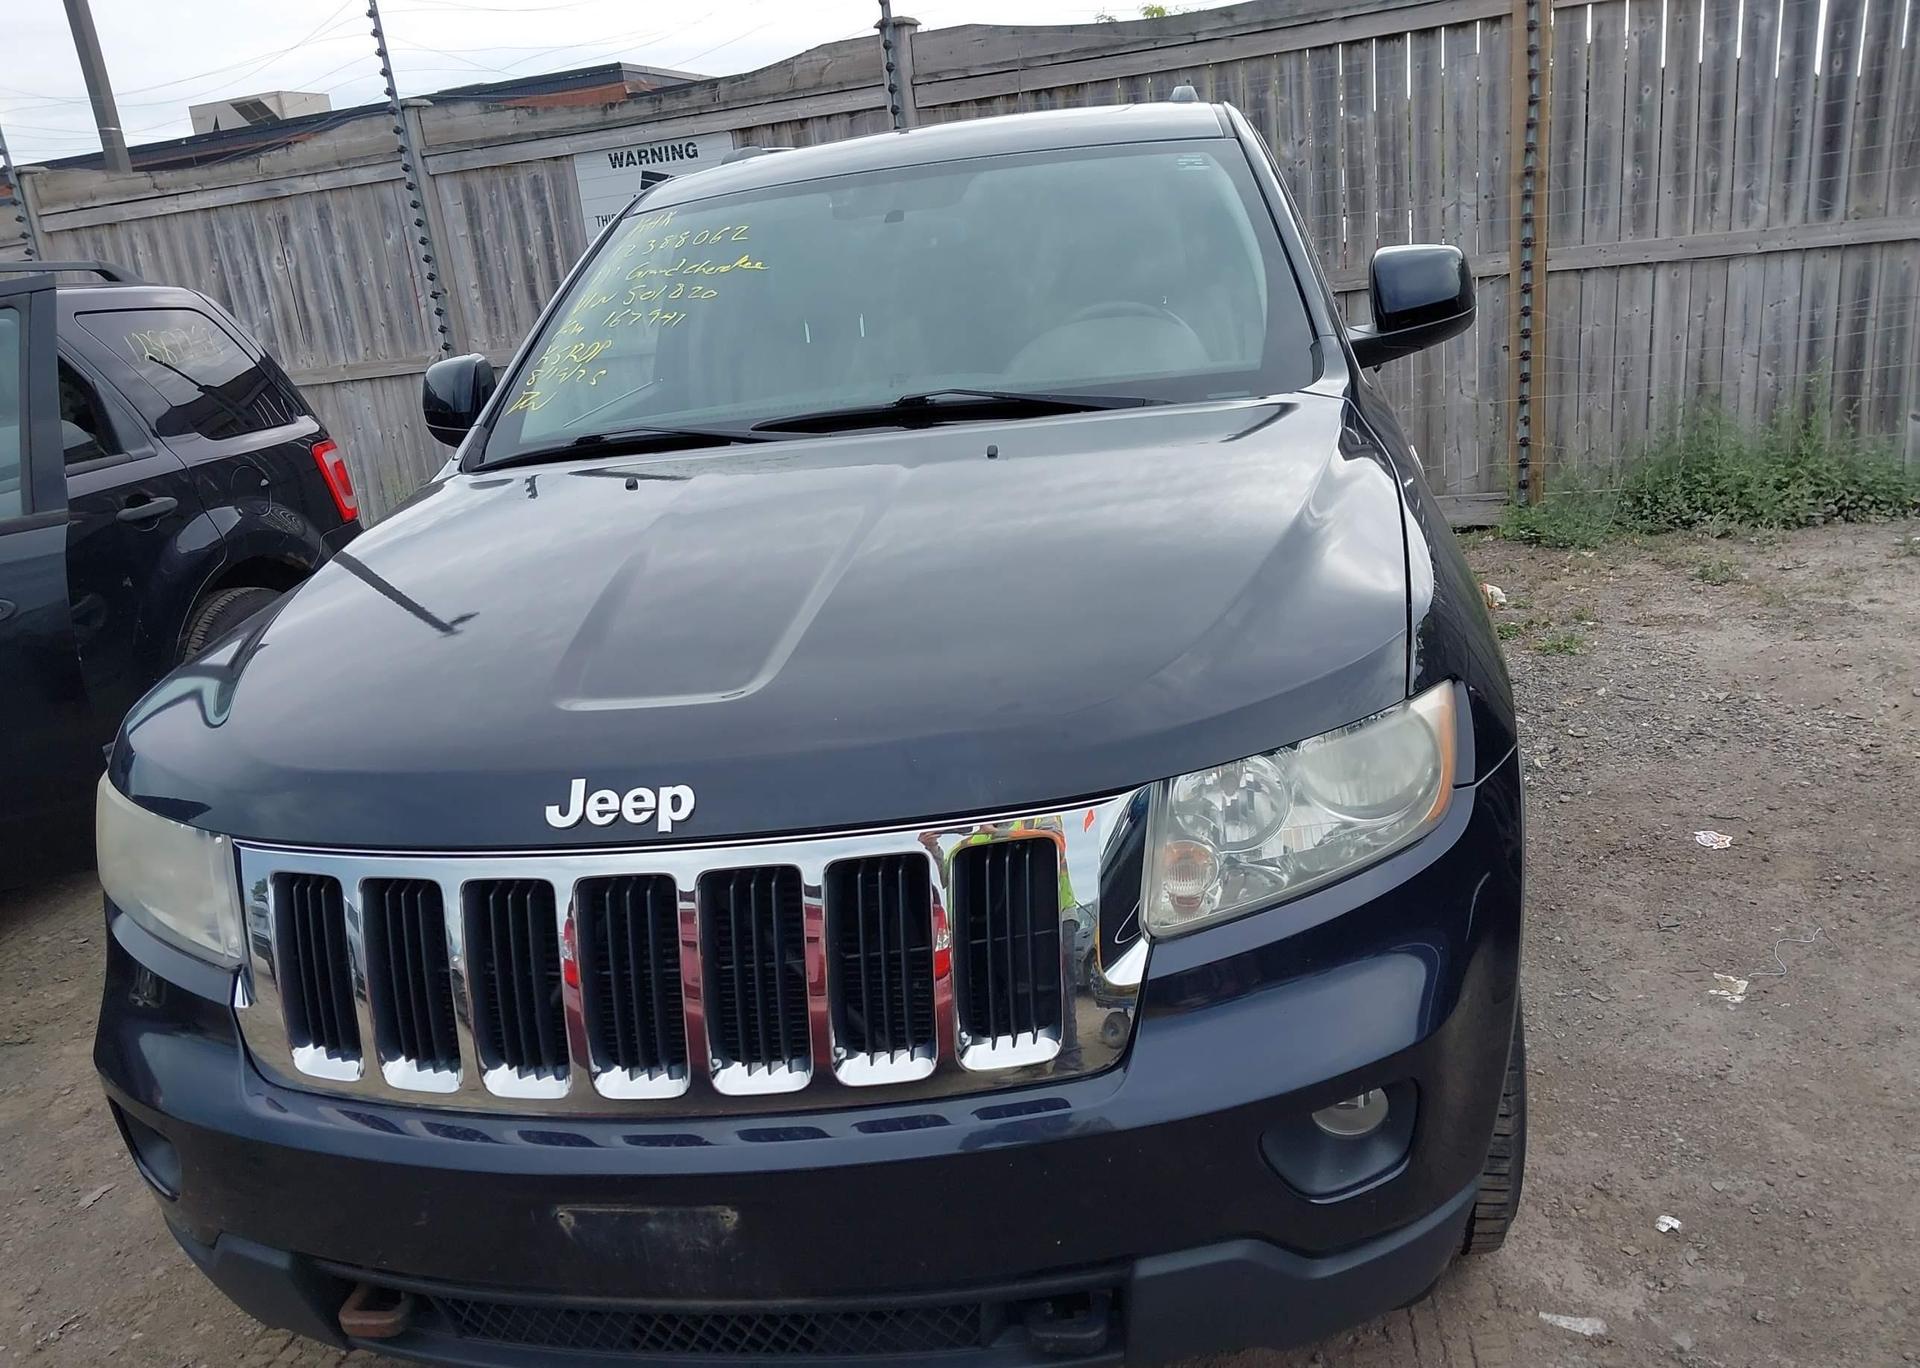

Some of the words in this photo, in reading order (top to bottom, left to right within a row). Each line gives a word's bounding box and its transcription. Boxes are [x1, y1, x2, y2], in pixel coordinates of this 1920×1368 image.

[608, 142, 698, 169] WARNING
[623, 283, 719, 306] 501820
[545, 778, 695, 833] Jeep
